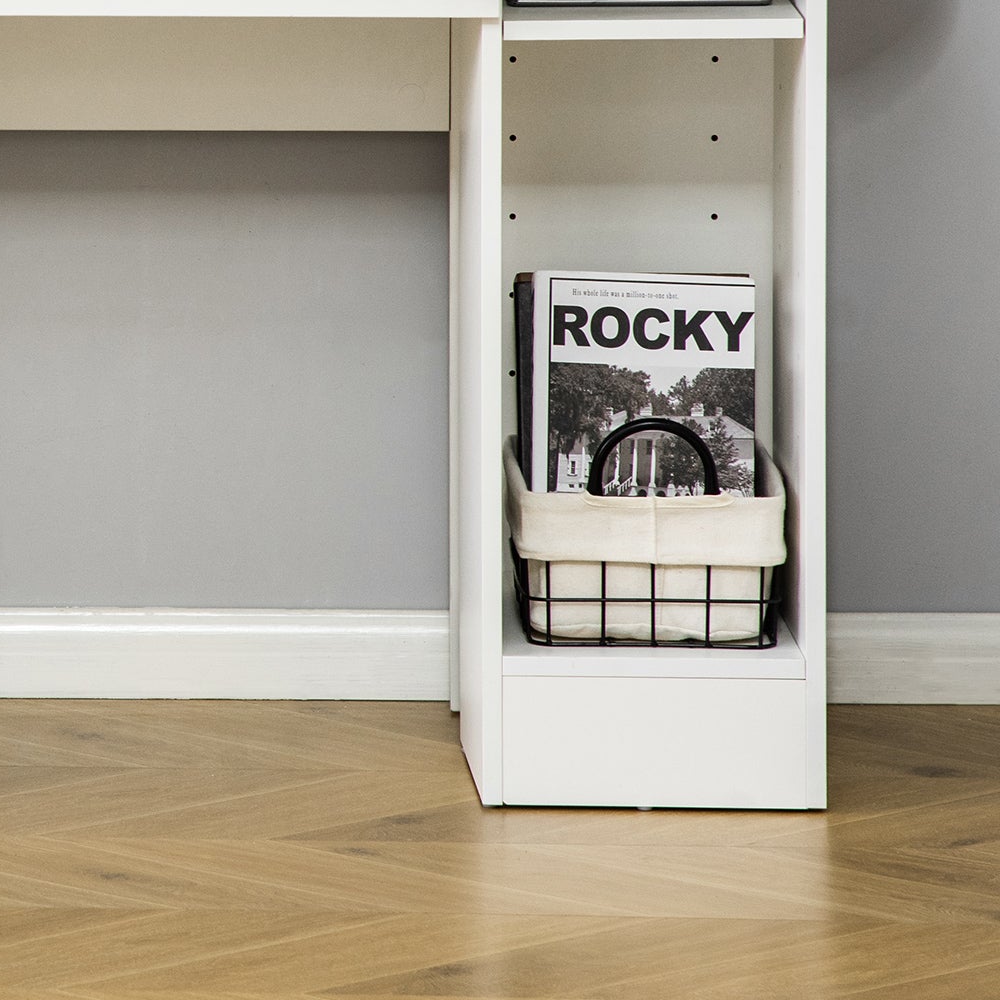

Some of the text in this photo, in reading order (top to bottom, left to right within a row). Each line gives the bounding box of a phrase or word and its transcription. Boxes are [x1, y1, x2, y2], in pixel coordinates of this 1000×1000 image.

[571, 288, 582, 297] His
[583, 289, 599, 297] whole
[600, 289, 609, 298] life
[553, 304, 755, 352] ROCKY
